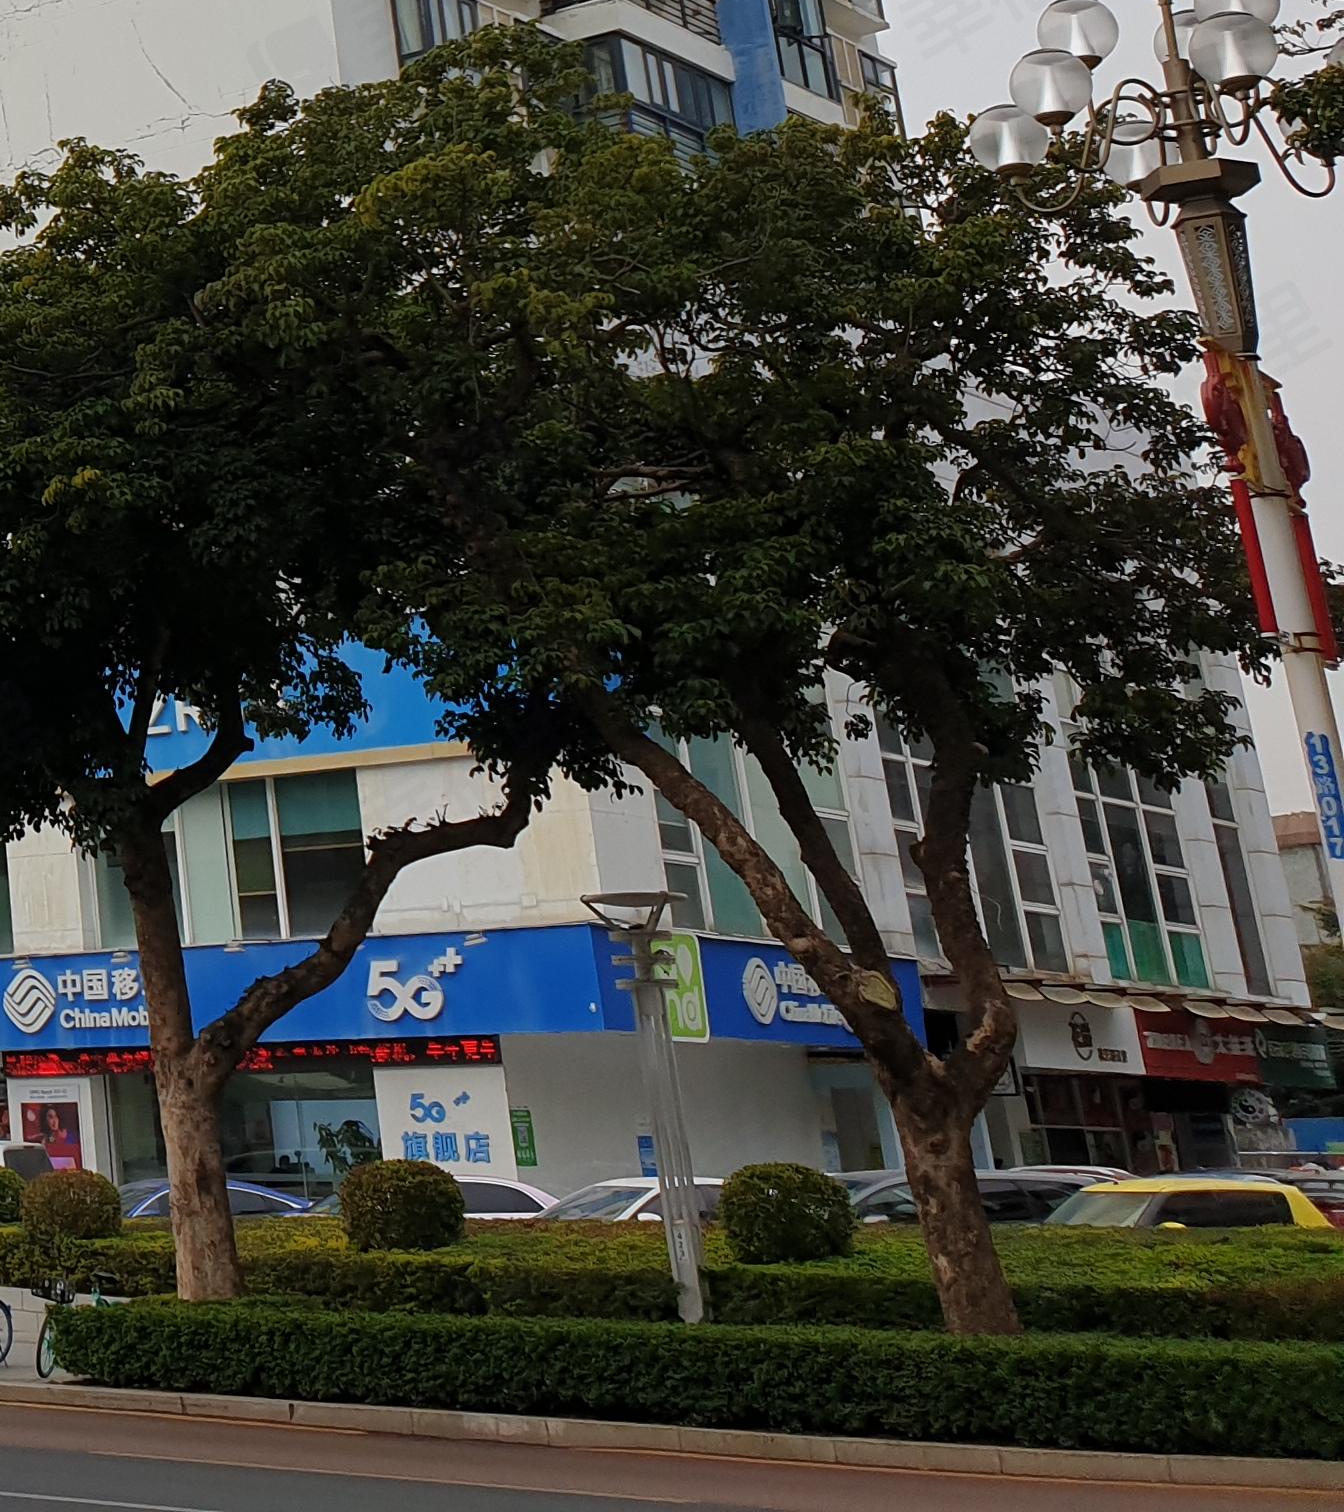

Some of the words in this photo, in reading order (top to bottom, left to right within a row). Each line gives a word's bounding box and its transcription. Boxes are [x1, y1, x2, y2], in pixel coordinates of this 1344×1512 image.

[57, 968, 146, 1002] 中国移
[59, 1006, 151, 1030] ChinaMob
[401, 1130, 491, 1164] 旗舰店
